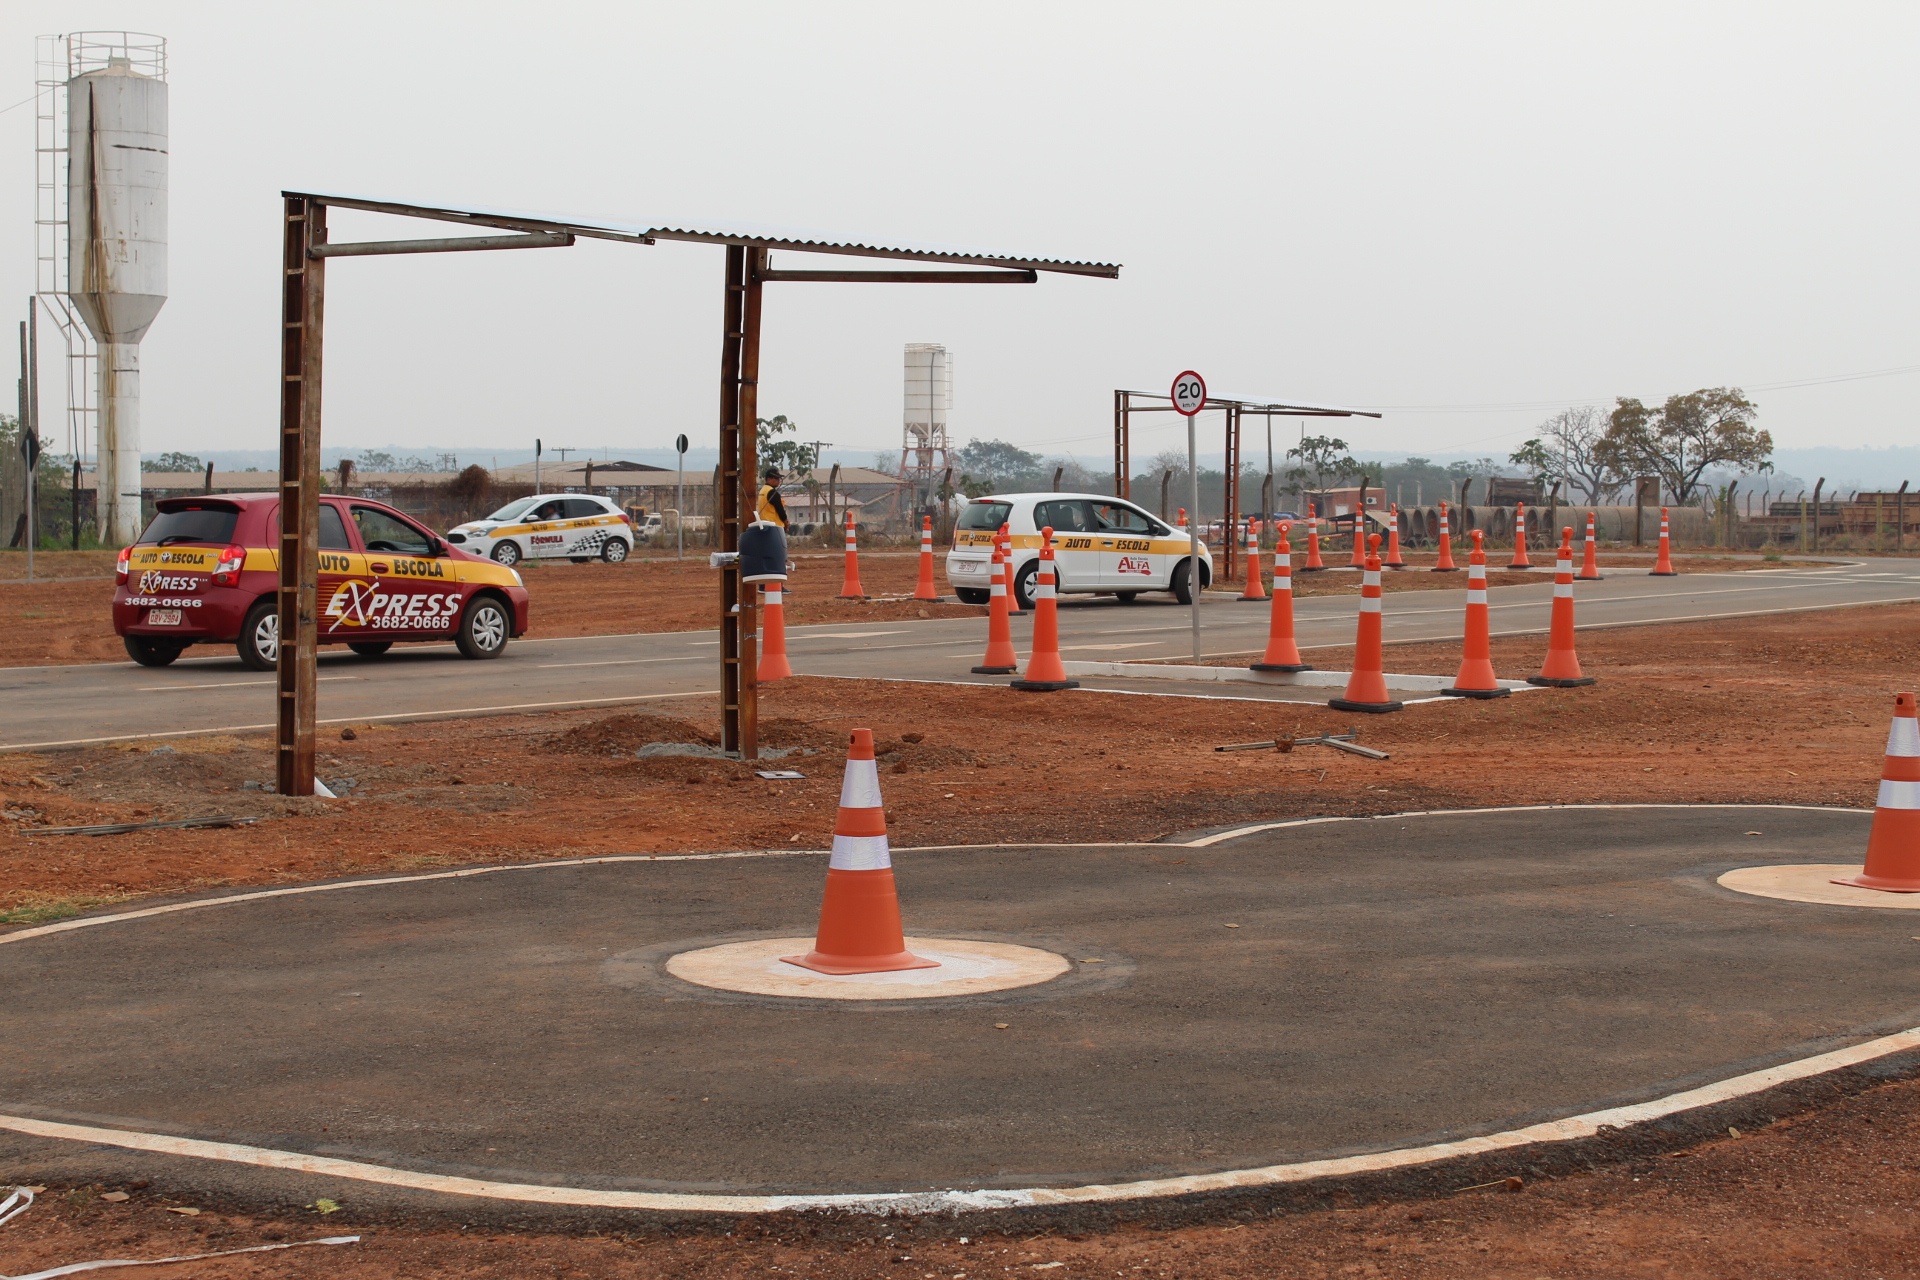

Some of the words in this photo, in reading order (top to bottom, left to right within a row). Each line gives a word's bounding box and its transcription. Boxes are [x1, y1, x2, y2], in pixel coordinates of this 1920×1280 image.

[1178, 382, 1200, 399] 20
[1065, 538, 1091, 549] AUTO
[1116, 539, 1150, 551] ESCOLA
[140, 552, 158, 564] AUTO
[171, 553, 205, 565] ESCOLA
[1118, 556, 1150, 570] ALFA
[317, 554, 350, 572] UTO
[393, 559, 444, 578] ESCOLA
[139, 571, 199, 596] EXPRESS
[124, 597, 203, 608] 3682-0666
[325, 582, 462, 634] EXPRESS
[371, 616, 450, 629] 3682-0666
